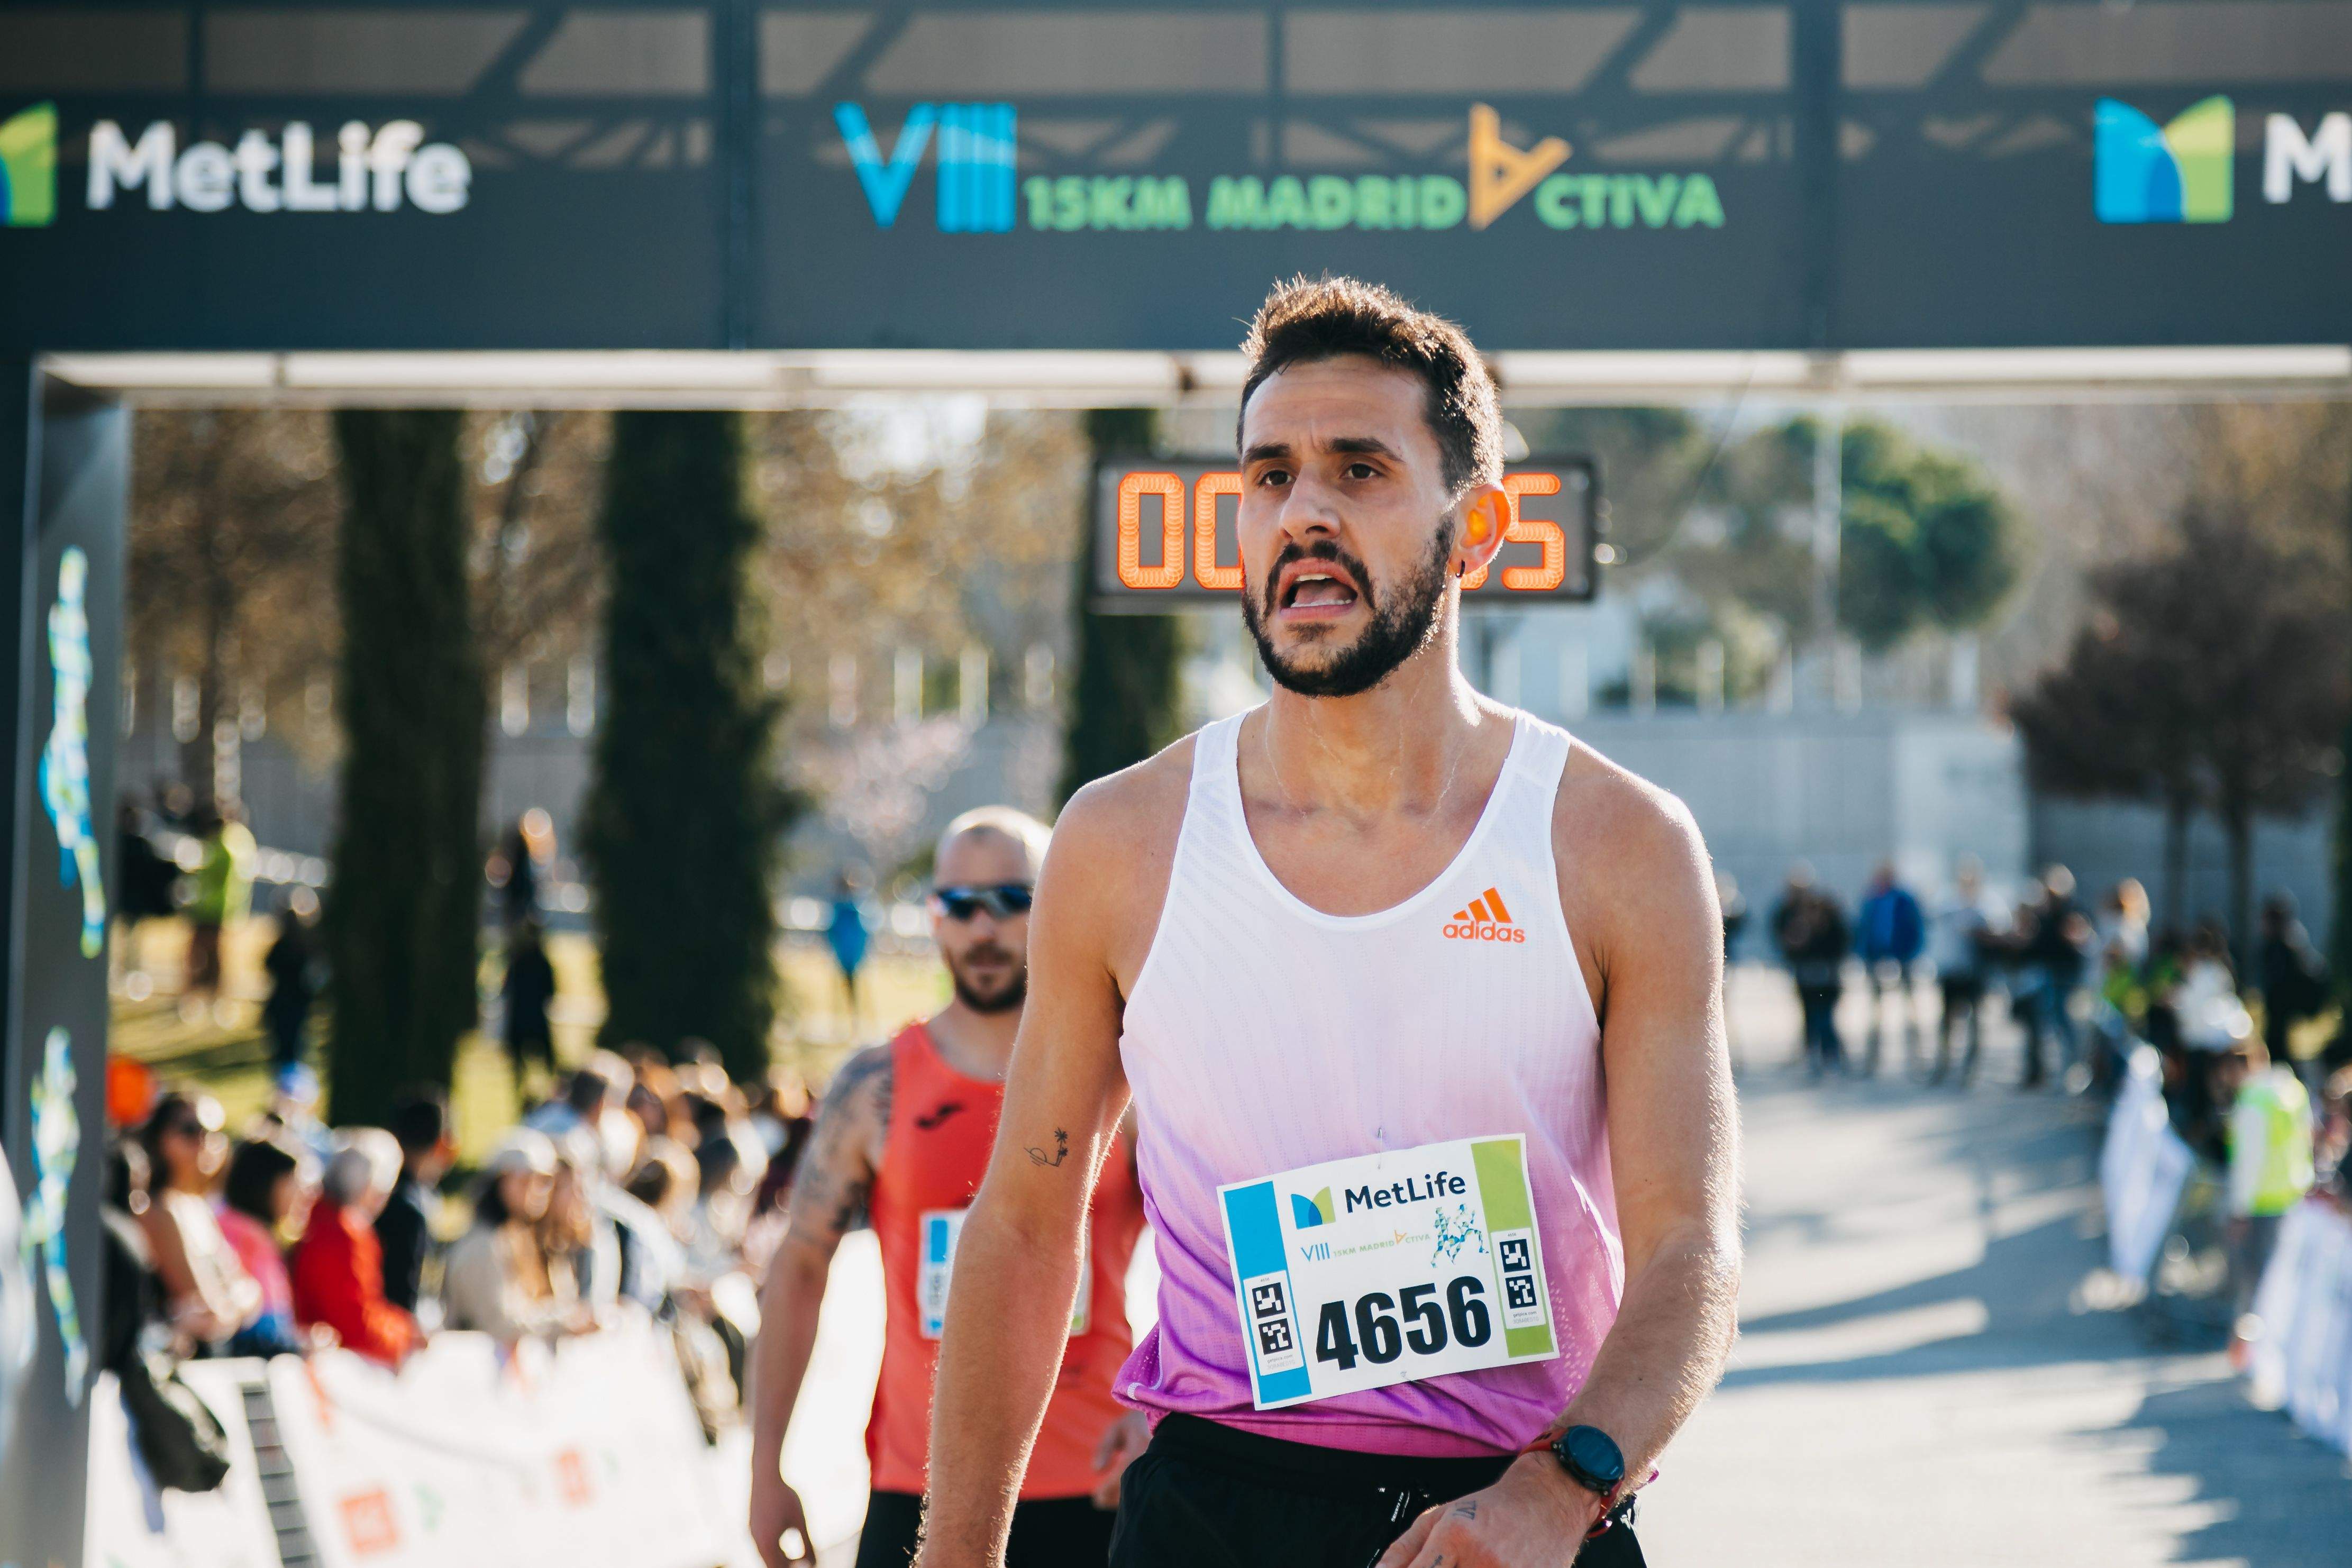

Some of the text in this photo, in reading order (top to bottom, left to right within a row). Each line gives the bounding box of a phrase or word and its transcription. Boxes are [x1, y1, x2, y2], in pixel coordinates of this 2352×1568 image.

[86, 118, 472, 213] MetLife
[1022, 175, 1193, 231] 15KM
[1205, 174, 1466, 231] MADRID
[1443, 920, 1526, 943] adidas
[1344, 1171, 1466, 1214] MetLife
[1300, 1242, 1330, 1262] VIII
[1333, 1248, 1357, 1257] 15KM
[1359, 1239, 1394, 1252] MADRID
[1316, 1275, 1492, 1371] 4656
